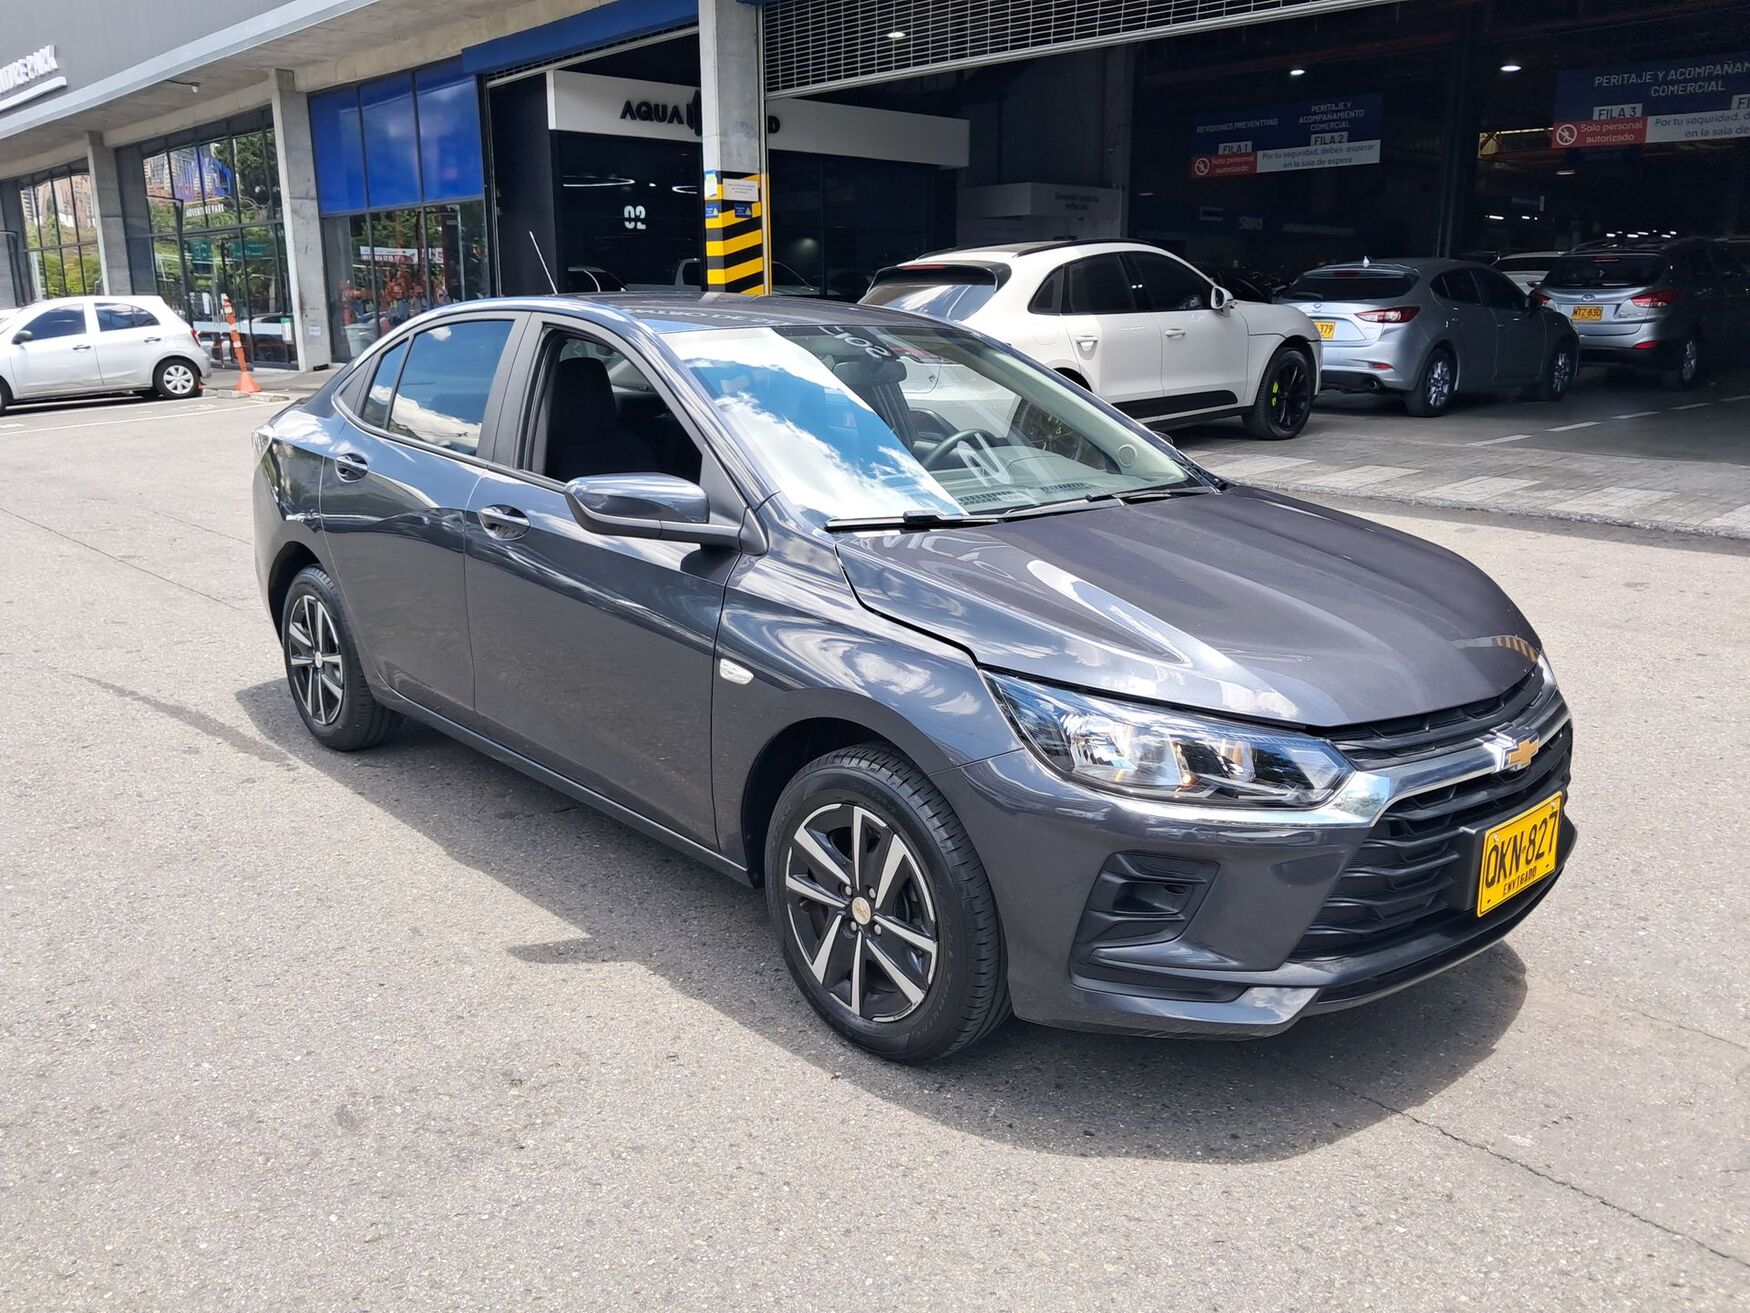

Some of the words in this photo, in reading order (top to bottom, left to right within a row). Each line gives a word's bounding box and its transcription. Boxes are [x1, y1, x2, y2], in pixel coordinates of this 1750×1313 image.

[1594, 71, 1655, 87] PERITAJE
[1657, 69, 1665, 81] Y
[1651, 79, 1727, 97] COMERCIAL
[620, 100, 683, 125] AQUA
[1310, 101, 1346, 114] PERITAJE
[1598, 107, 1627, 120] FILA
[1629, 106, 1637, 117] 3
[1234, 118, 1279, 129] PREVENTIVAS
[1310, 120, 1352, 131] COMERCIAL
[1580, 123, 1602, 133] Solo
[1602, 120, 1643, 133] personal
[1655, 117, 1671, 127] Por
[1673, 117, 1683, 126] tu
[1685, 129, 1698, 138] en
[1700, 127, 1709, 137] la
[1712, 126, 1733, 137] sala
[1314, 135, 1337, 146] FILA
[1338, 134, 1345, 144] 2
[1586, 133, 1635, 144] autorizado
[1223, 144, 1243, 153] FILA
[624, 205, 646, 230] 02
